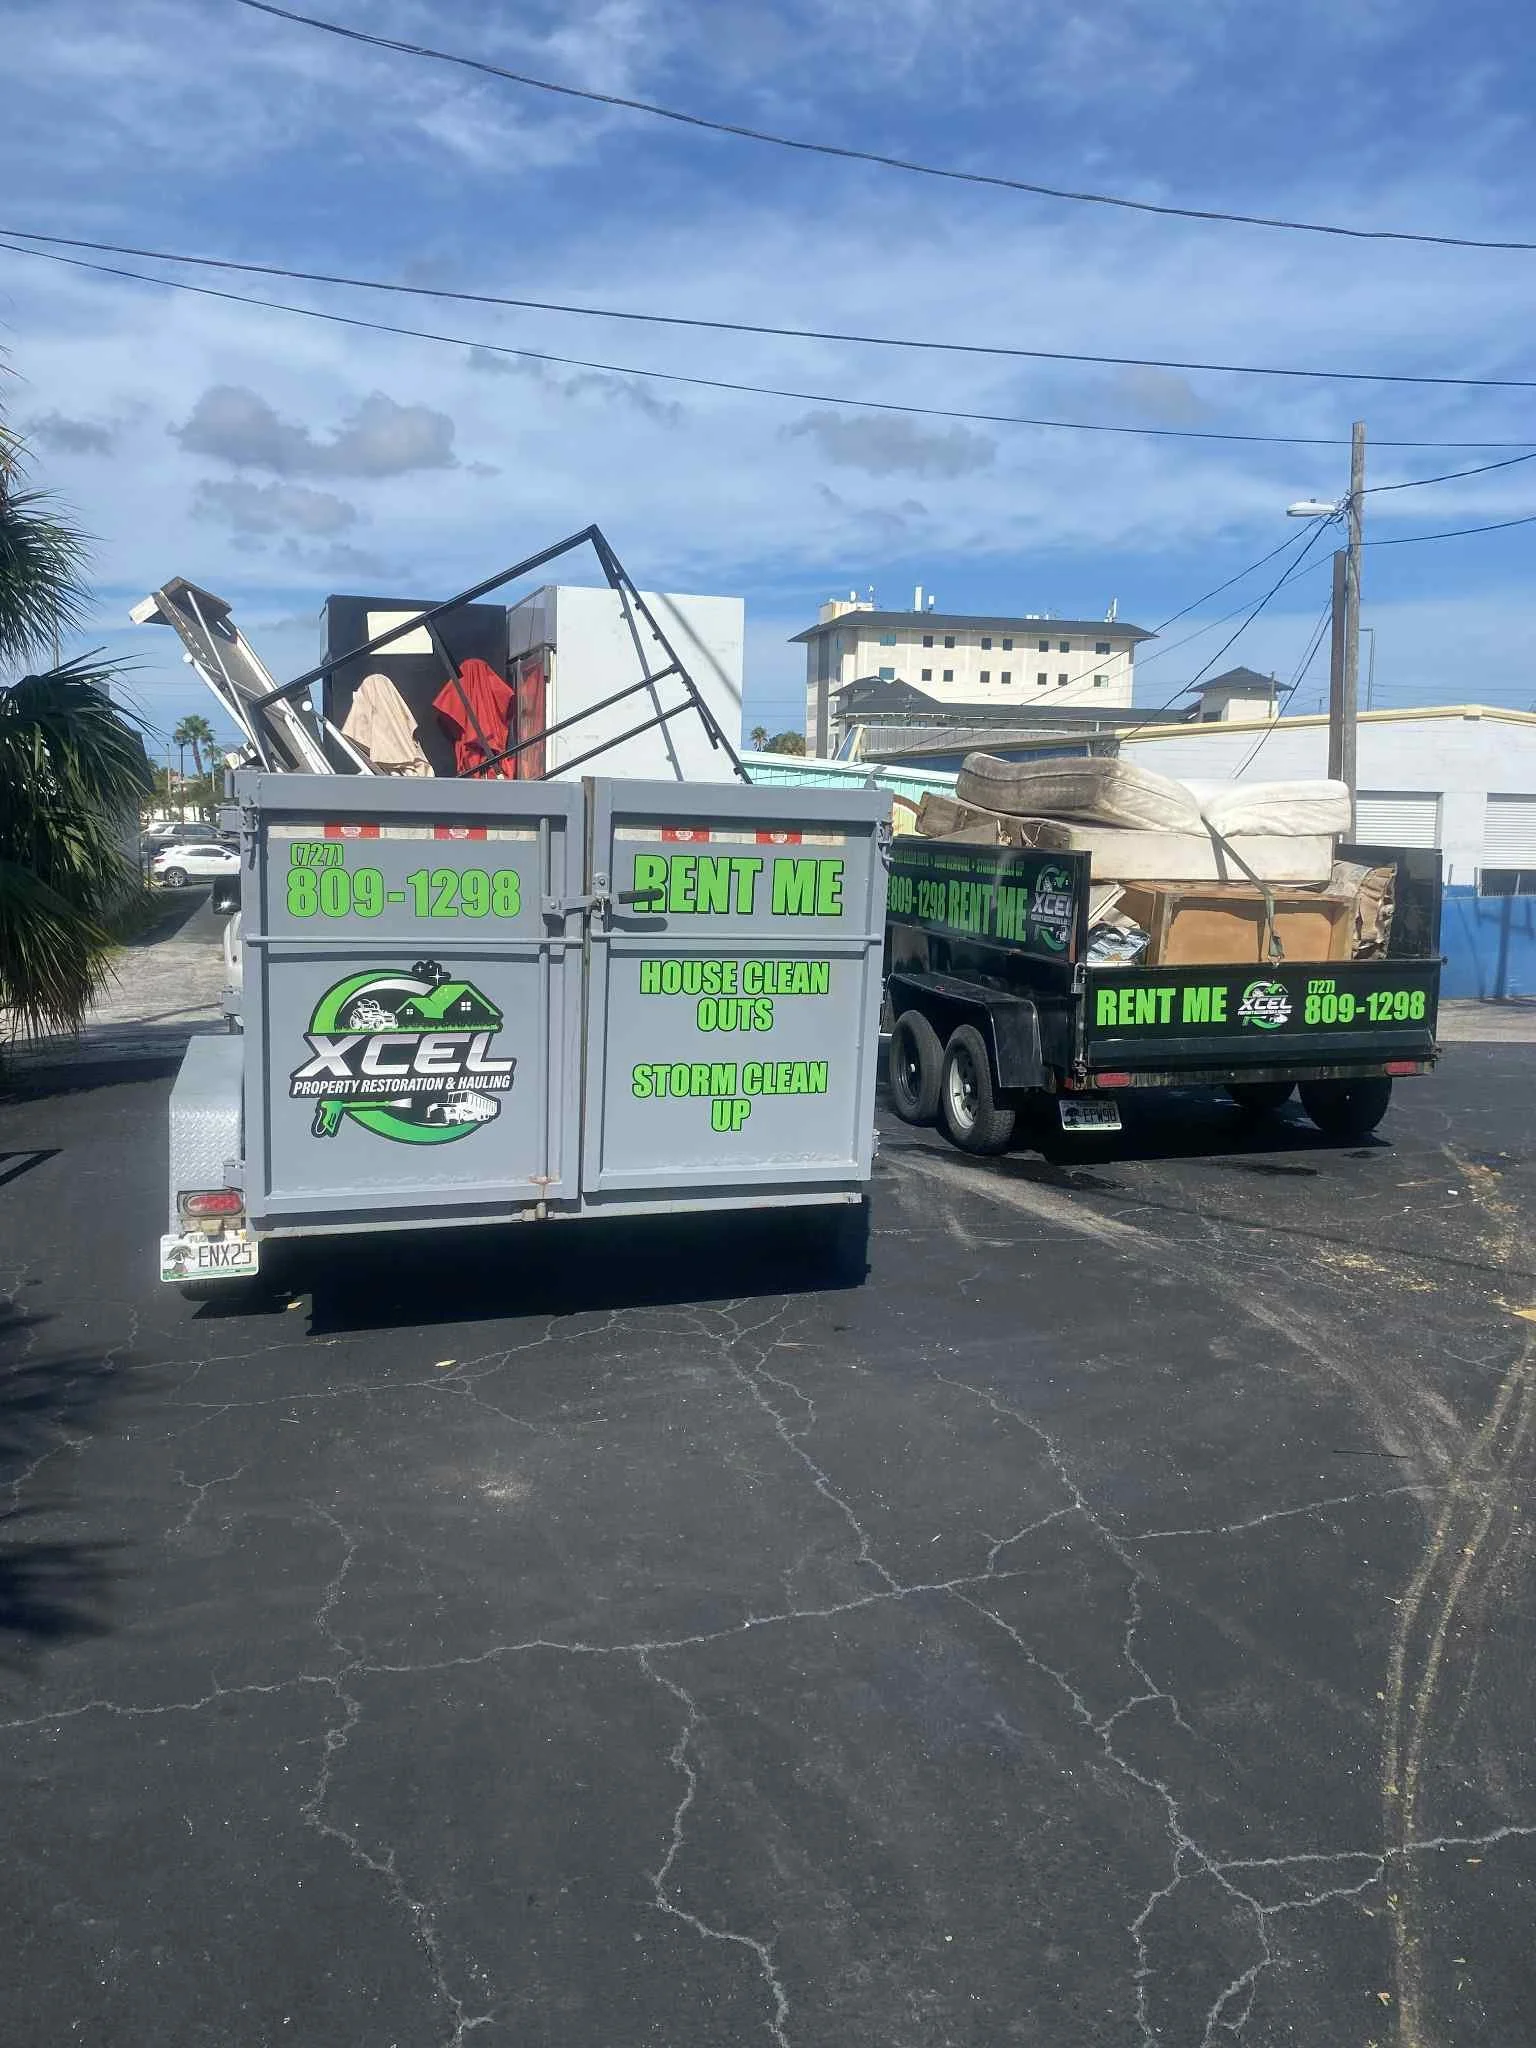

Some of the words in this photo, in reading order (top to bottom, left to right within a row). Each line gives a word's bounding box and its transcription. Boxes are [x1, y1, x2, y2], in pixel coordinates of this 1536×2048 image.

[290, 843, 344, 866] (727)
[287, 867, 521, 918] 809-1298
[633, 854, 764, 914] RENT
[771, 858, 845, 916] ME
[890, 874, 946, 921] 809-1298
[947, 879, 993, 936] RENT
[995, 886, 1028, 942] ME
[639, 960, 738, 995] HOUSE
[742, 960, 831, 995] CLEAN
[697, 997, 774, 1032] OUTS
[1096, 987, 1176, 1026] RENT
[1182, 986, 1228, 1023] ME
[1237, 997, 1293, 1011] XCEL
[1304, 991, 1426, 1025] 809-1298
[295, 1031, 514, 1078] XCEL
[293, 1079, 361, 1096] PROPERTY
[361, 1076, 444, 1093] RESTORATION
[446, 1076, 455, 1090] &
[457, 1074, 511, 1090] HAULING
[632, 1062, 738, 1098] STORM
[742, 1061, 829, 1096] CLEAN
[711, 1099, 752, 1132] UP
[198, 1243, 252, 1268] ENX25
